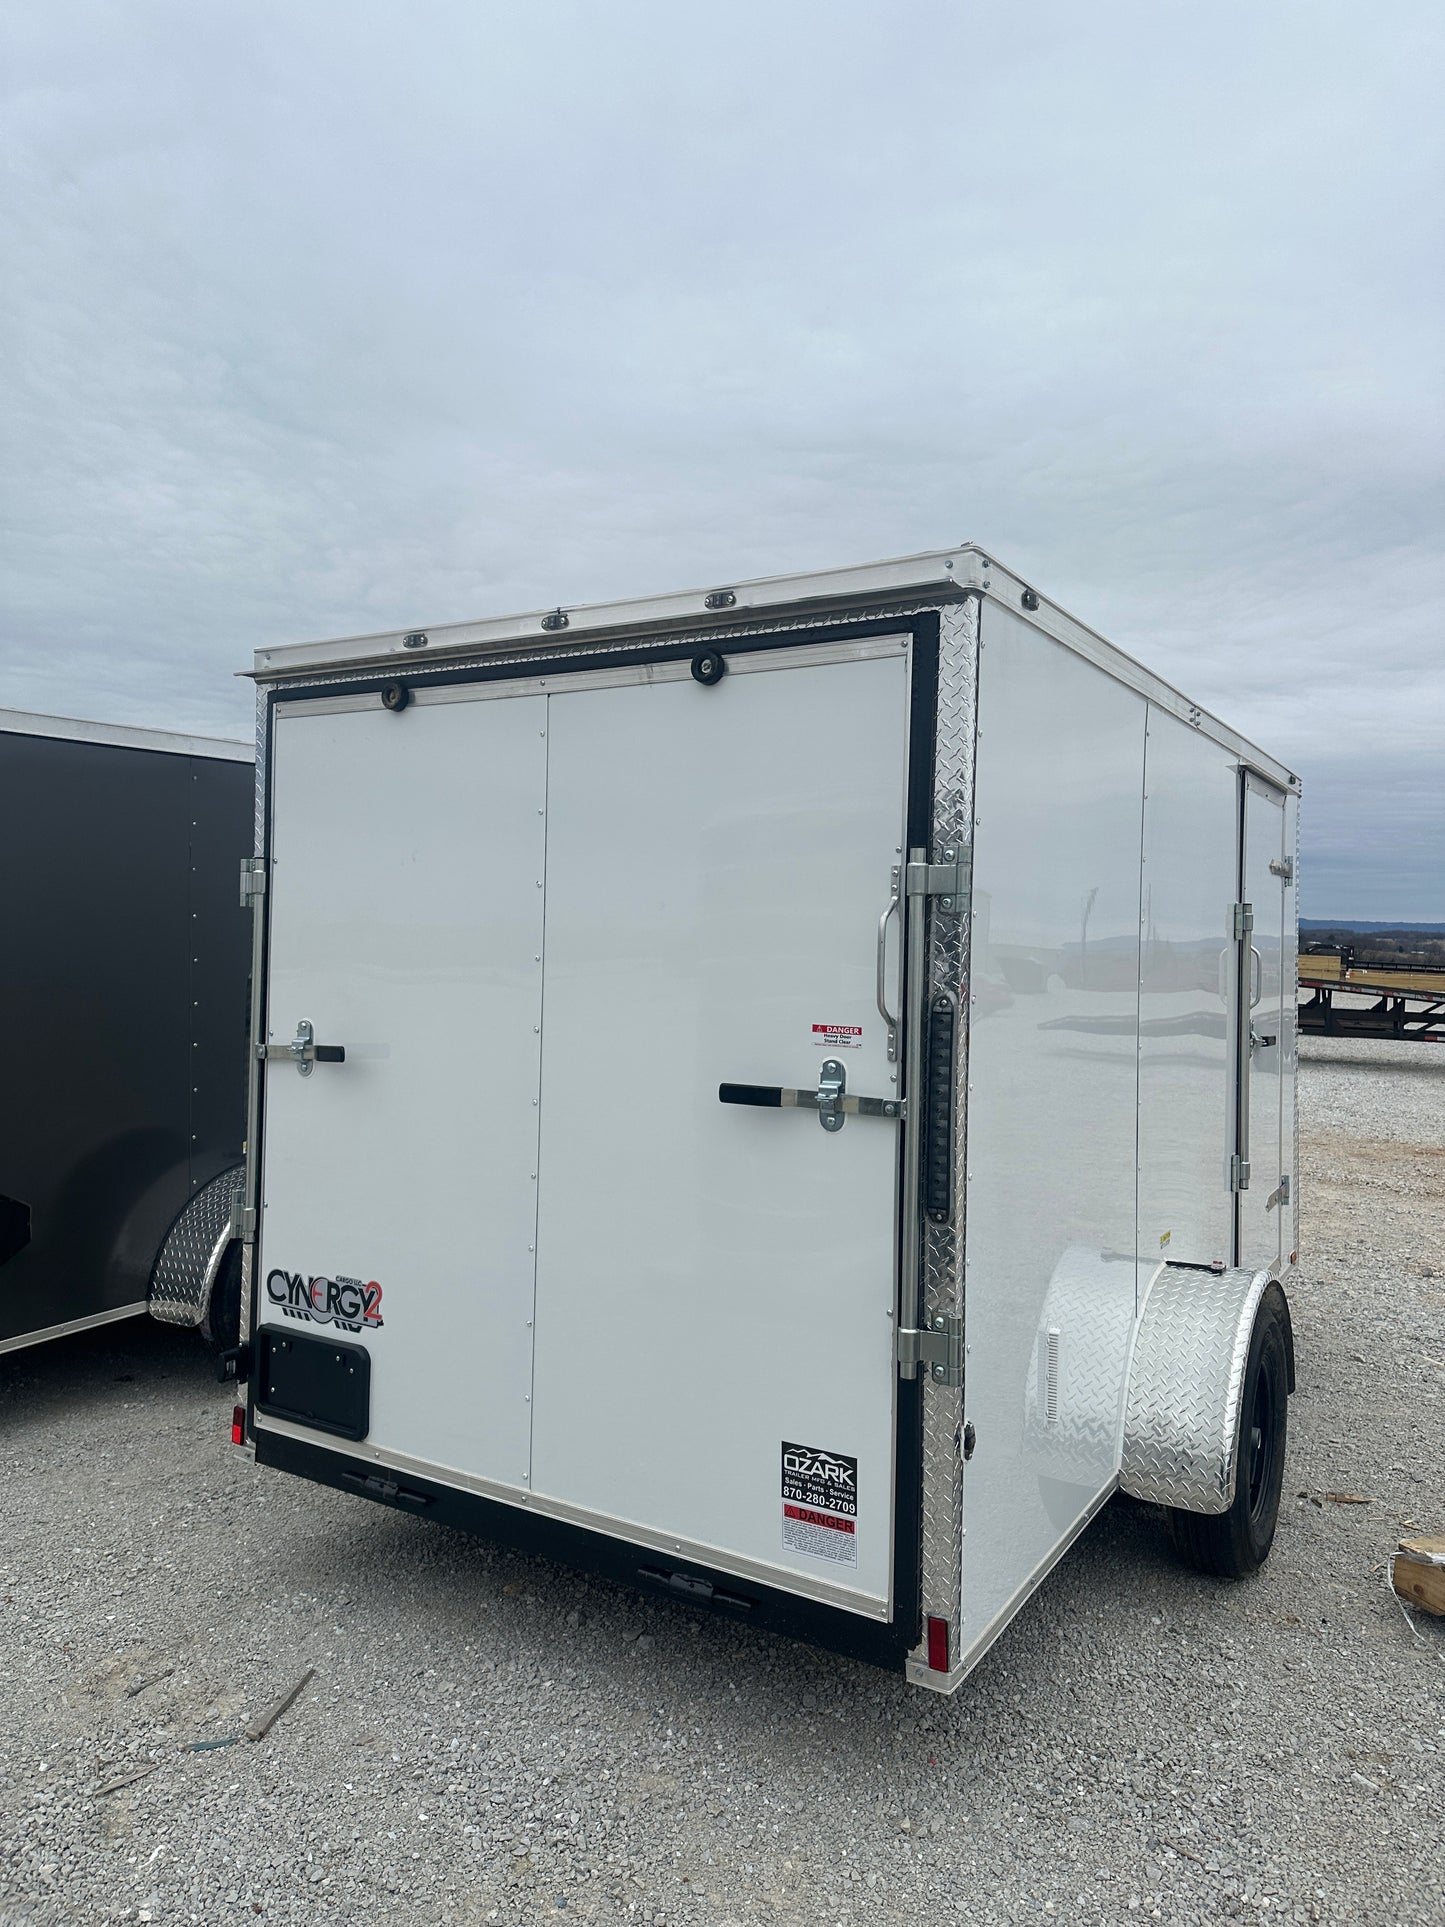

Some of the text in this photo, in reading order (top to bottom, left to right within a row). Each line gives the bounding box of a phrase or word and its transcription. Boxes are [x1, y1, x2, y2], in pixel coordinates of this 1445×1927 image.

[826, 1026, 860, 1034] DANGER
[784, 1454, 855, 1486] OZARK
[784, 1470, 810, 1480] TRAILER
[811, 1476, 826, 1484] MFG
[834, 1482, 856, 1492] SALES
[783, 1486, 856, 1514] 870-280-2709
[785, 1476, 854, 1501] Sales Parts Service
[799, 1508, 854, 1533] DANGER
